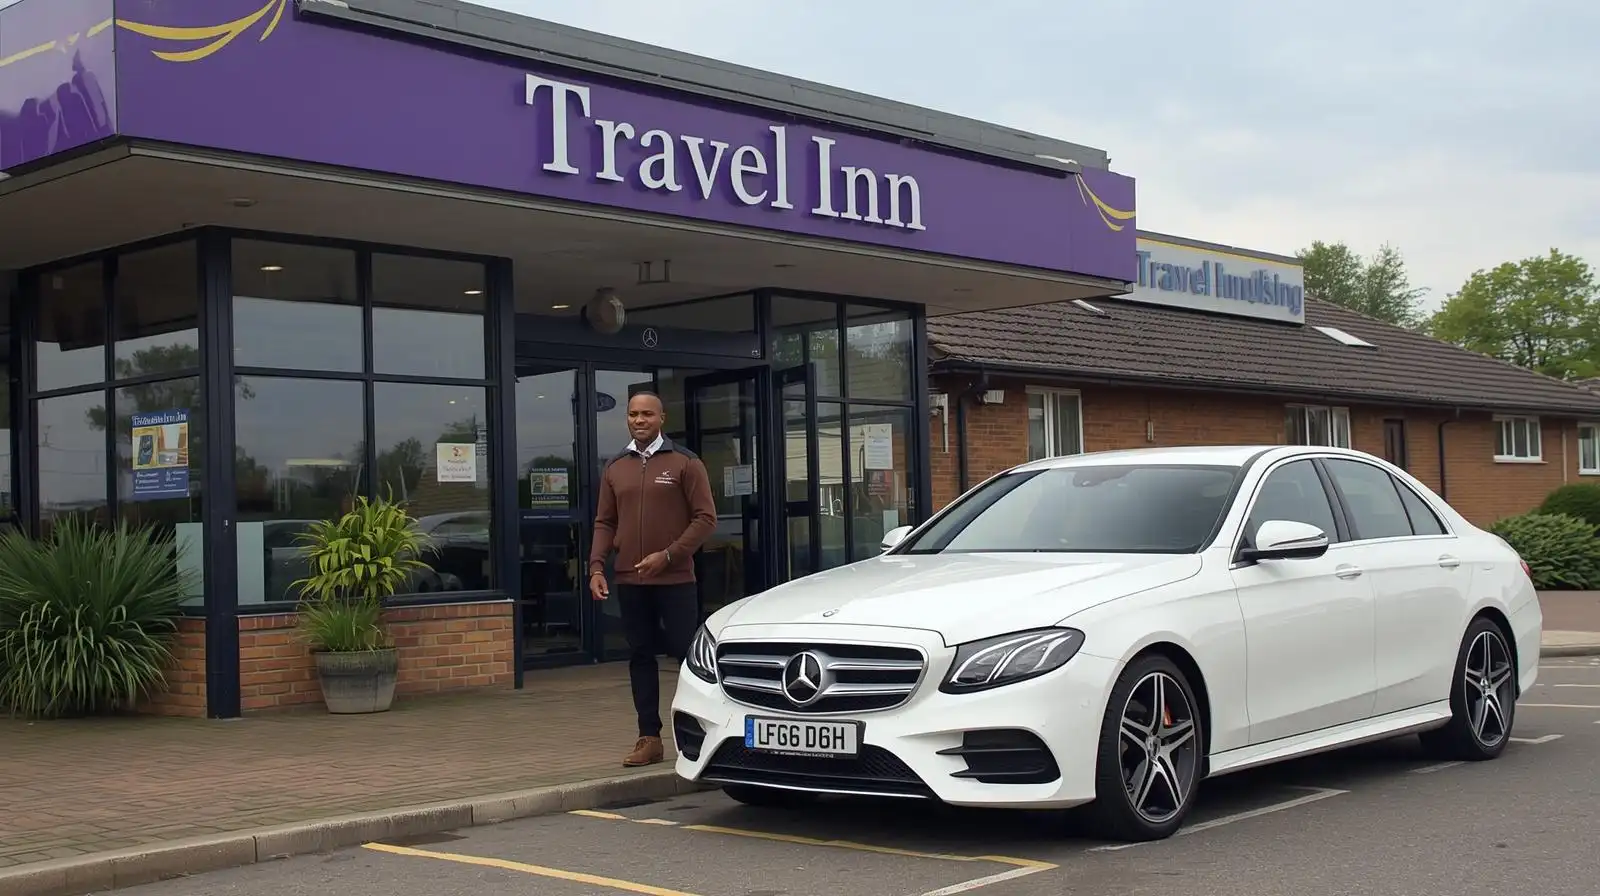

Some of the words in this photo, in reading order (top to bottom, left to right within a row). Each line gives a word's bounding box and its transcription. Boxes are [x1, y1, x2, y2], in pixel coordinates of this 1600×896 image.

[525, 73, 793, 210] Travel
[811, 135, 927, 231] Inn
[1137, 251, 1211, 296] Travel
